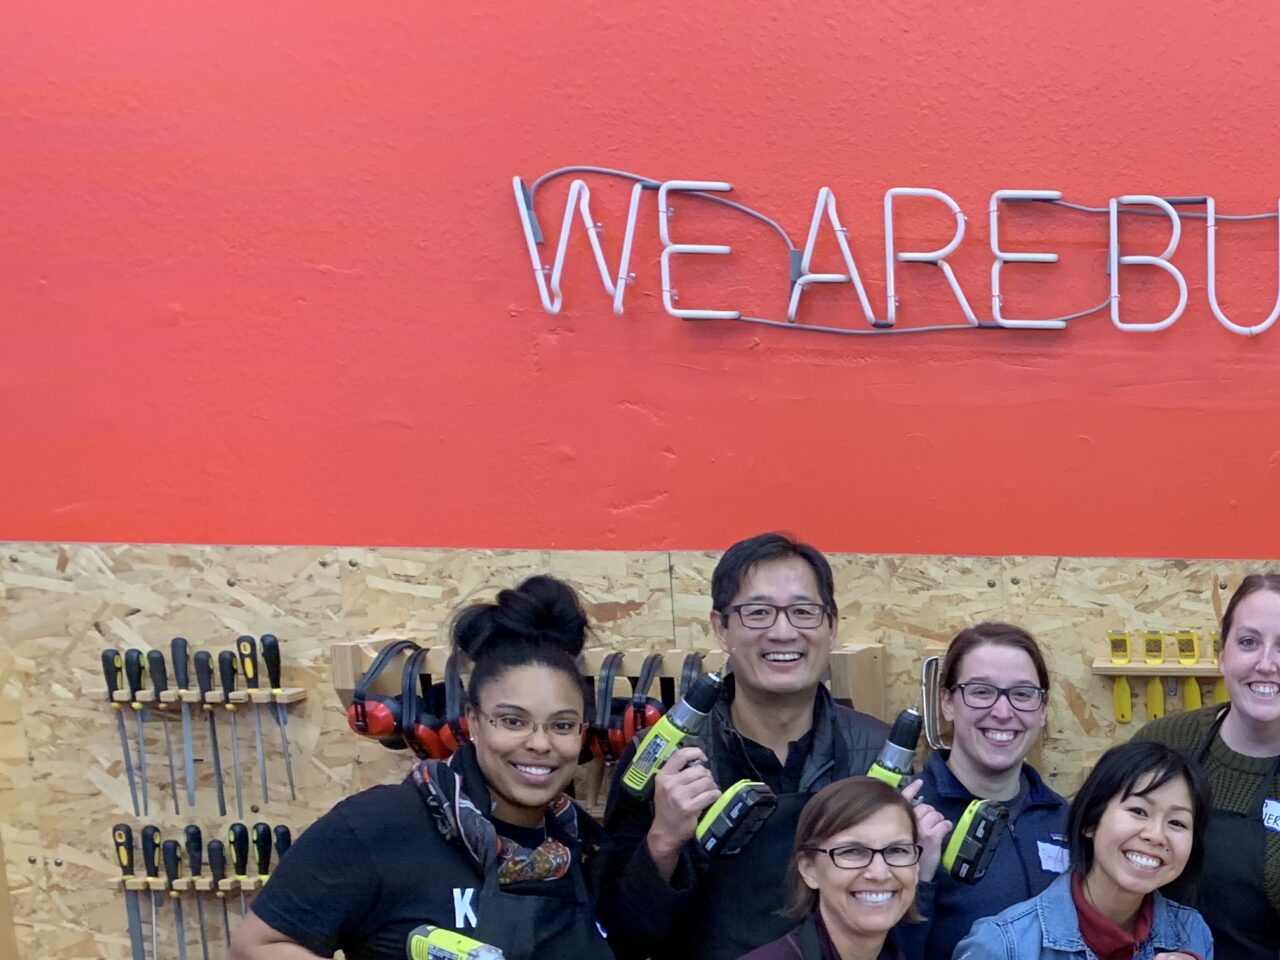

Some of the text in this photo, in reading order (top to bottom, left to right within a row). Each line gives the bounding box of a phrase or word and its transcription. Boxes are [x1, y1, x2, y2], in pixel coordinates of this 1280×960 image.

[512, 175, 740, 319] WE
[787, 186, 1067, 329] ARE
[452, 887, 478, 929] K
